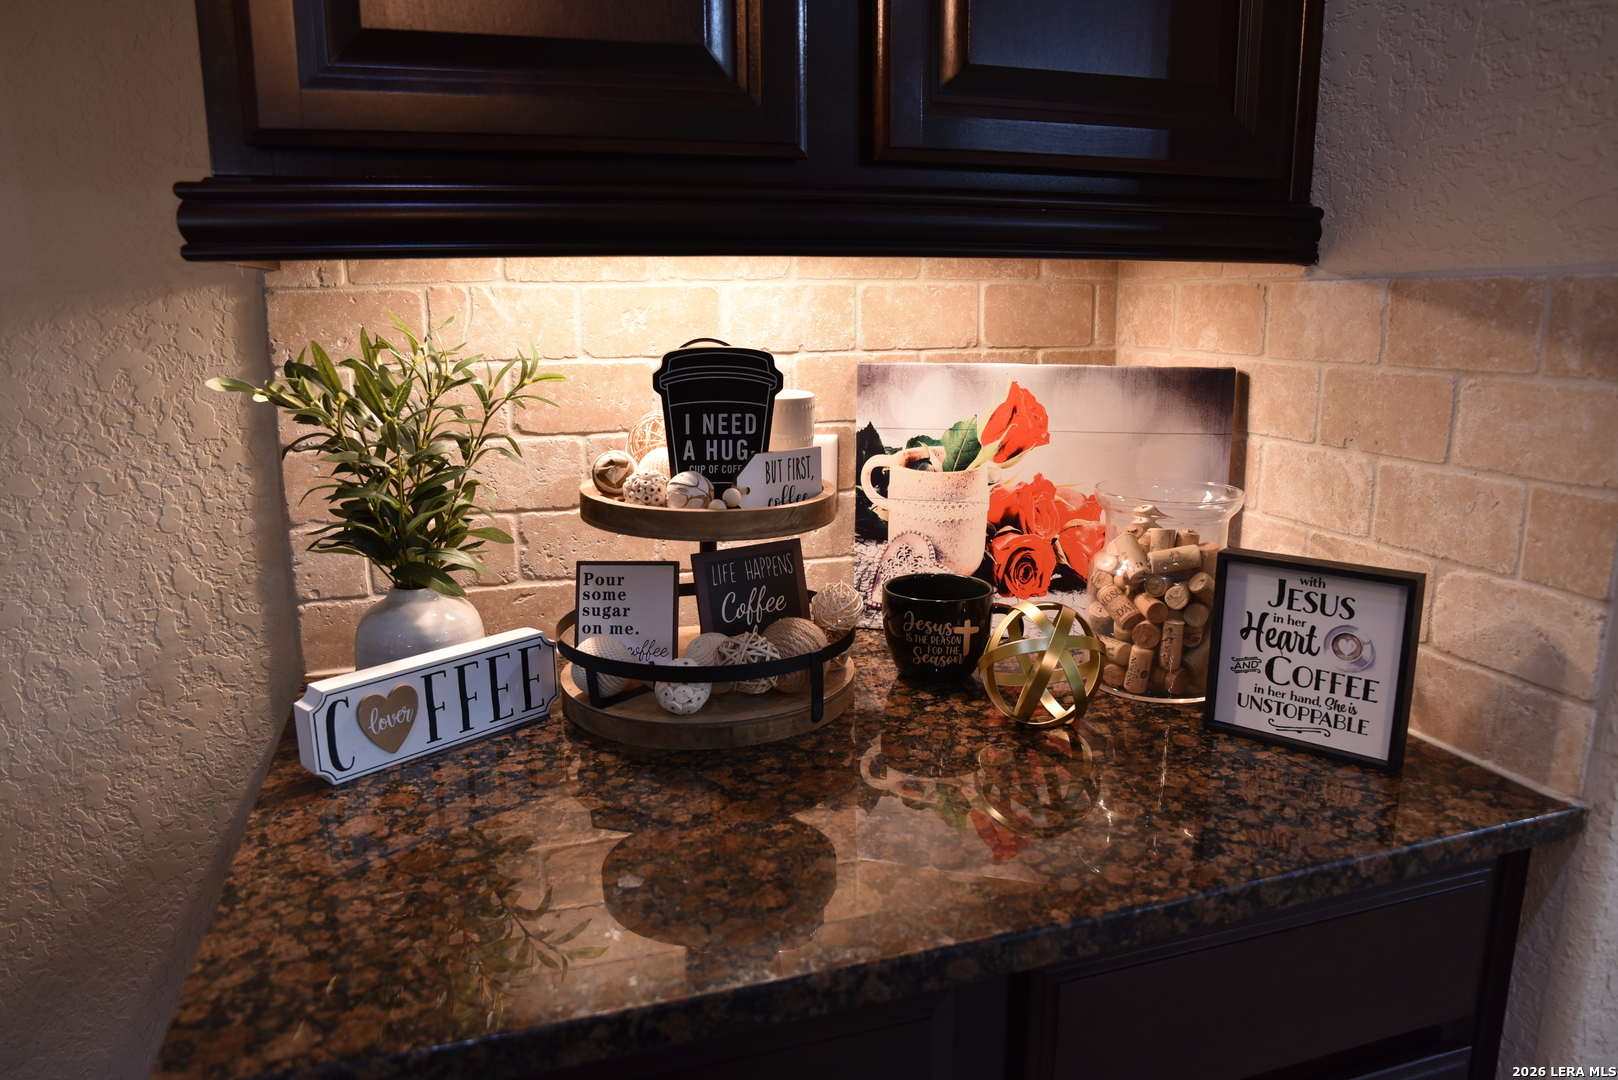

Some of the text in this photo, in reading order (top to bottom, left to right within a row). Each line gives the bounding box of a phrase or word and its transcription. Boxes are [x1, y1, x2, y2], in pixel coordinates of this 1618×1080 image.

[685, 413, 757, 435] I NEED
[683, 439, 756, 461] A HUG
[689, 464, 706, 474] CUP
[708, 464, 719, 474] OF
[765, 455, 815, 485] BUT FIRST,
[583, 572, 625, 586] Pour
[711, 552, 794, 586] LIFE HAPPENS
[1299, 577, 1326, 589] with
[582, 590, 627, 601] some
[721, 585, 788, 625] Coffee
[1267, 578, 1356, 620] JESUS
[582, 606, 631, 619] sugar
[903, 610, 954, 636] Jesus
[1273, 613, 1307, 628] in her
[582, 623, 640, 635] on me.
[905, 632, 961, 645] IS THE REASON
[1239, 611, 1321, 656] Heart
[912, 646, 964, 667] Season
[927, 646, 960, 655] FOR THE
[1234, 660, 1259, 670] AND
[1265, 655, 1380, 704] COFFEE
[1254, 683, 1358, 715] in her hand, She is
[367, 705, 414, 735] lover
[1237, 692, 1370, 736] UNSTOPPABLE
